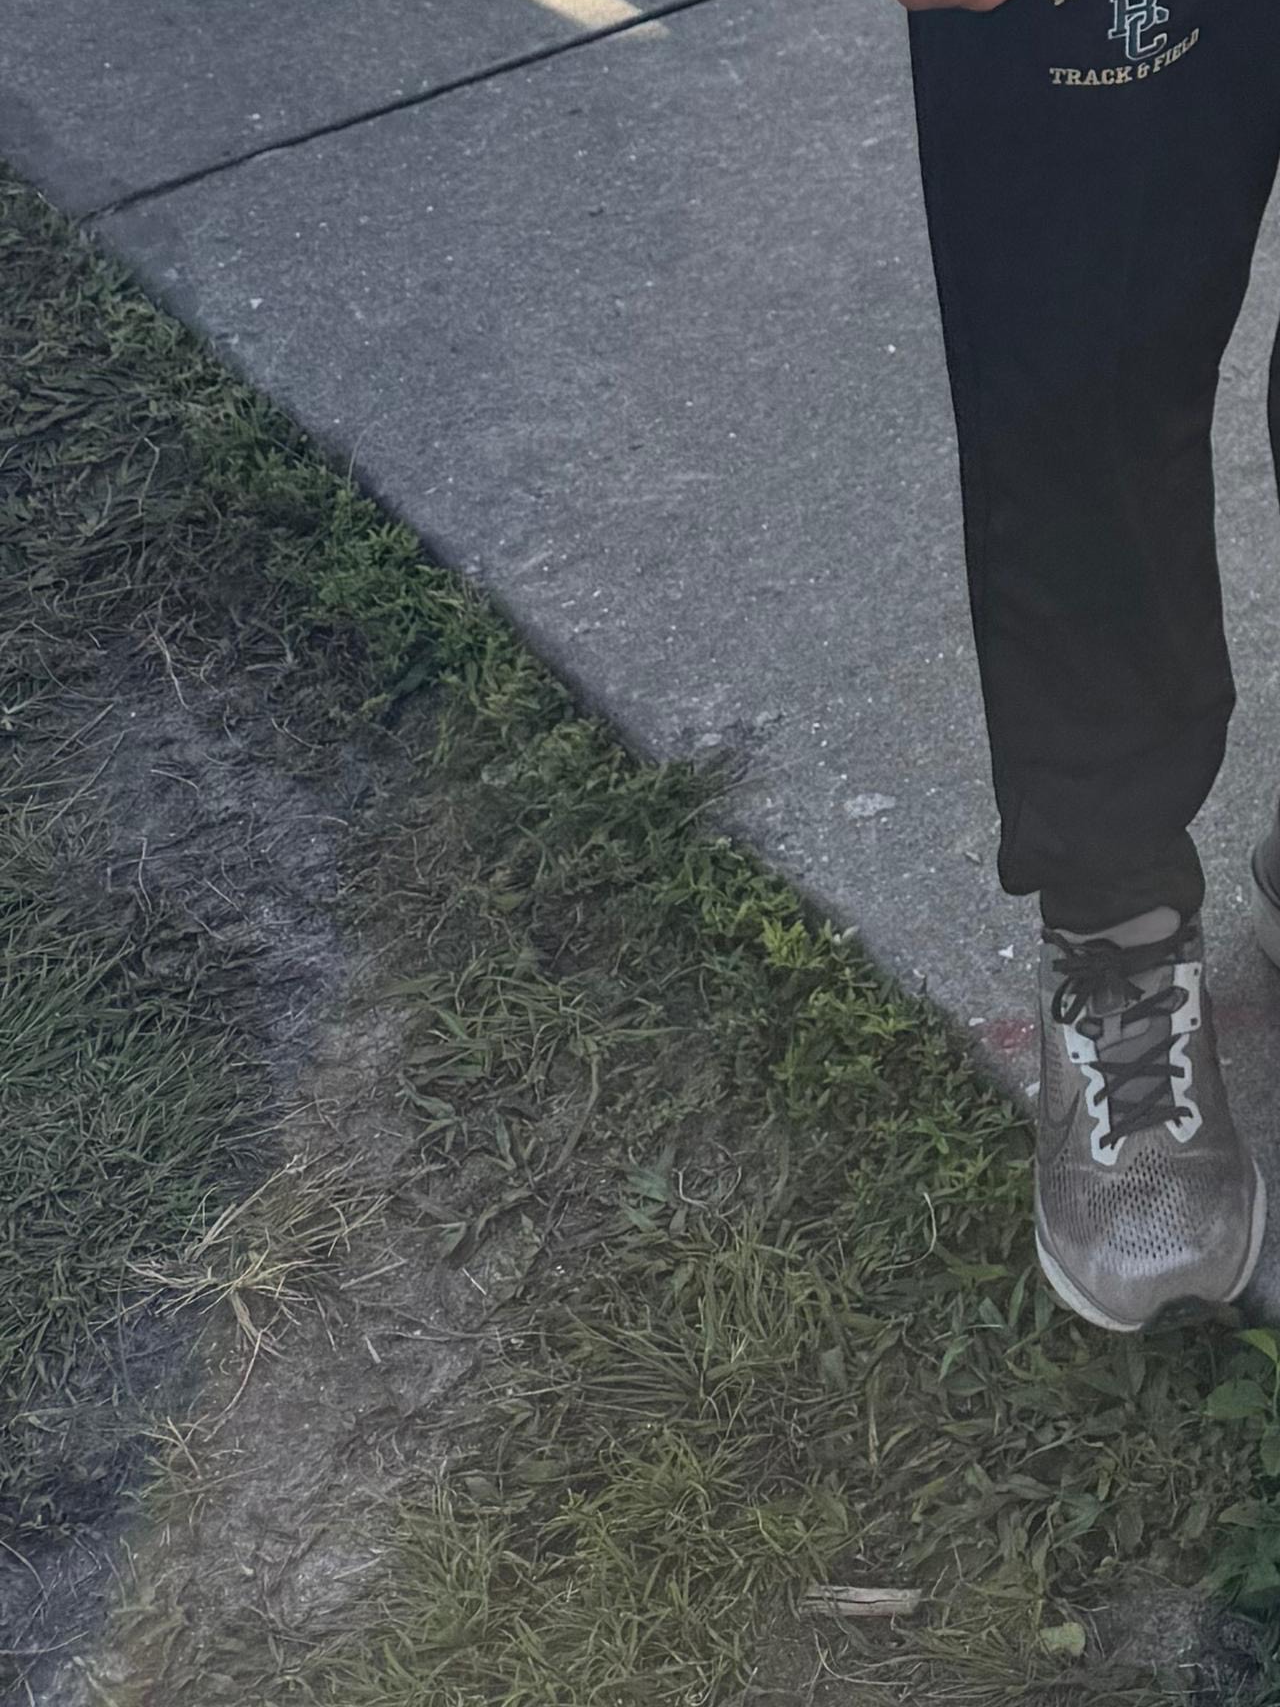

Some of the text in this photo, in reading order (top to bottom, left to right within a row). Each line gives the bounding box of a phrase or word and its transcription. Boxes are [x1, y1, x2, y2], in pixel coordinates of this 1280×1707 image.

[1049, 27, 1200, 86] TRACK & FIELD
